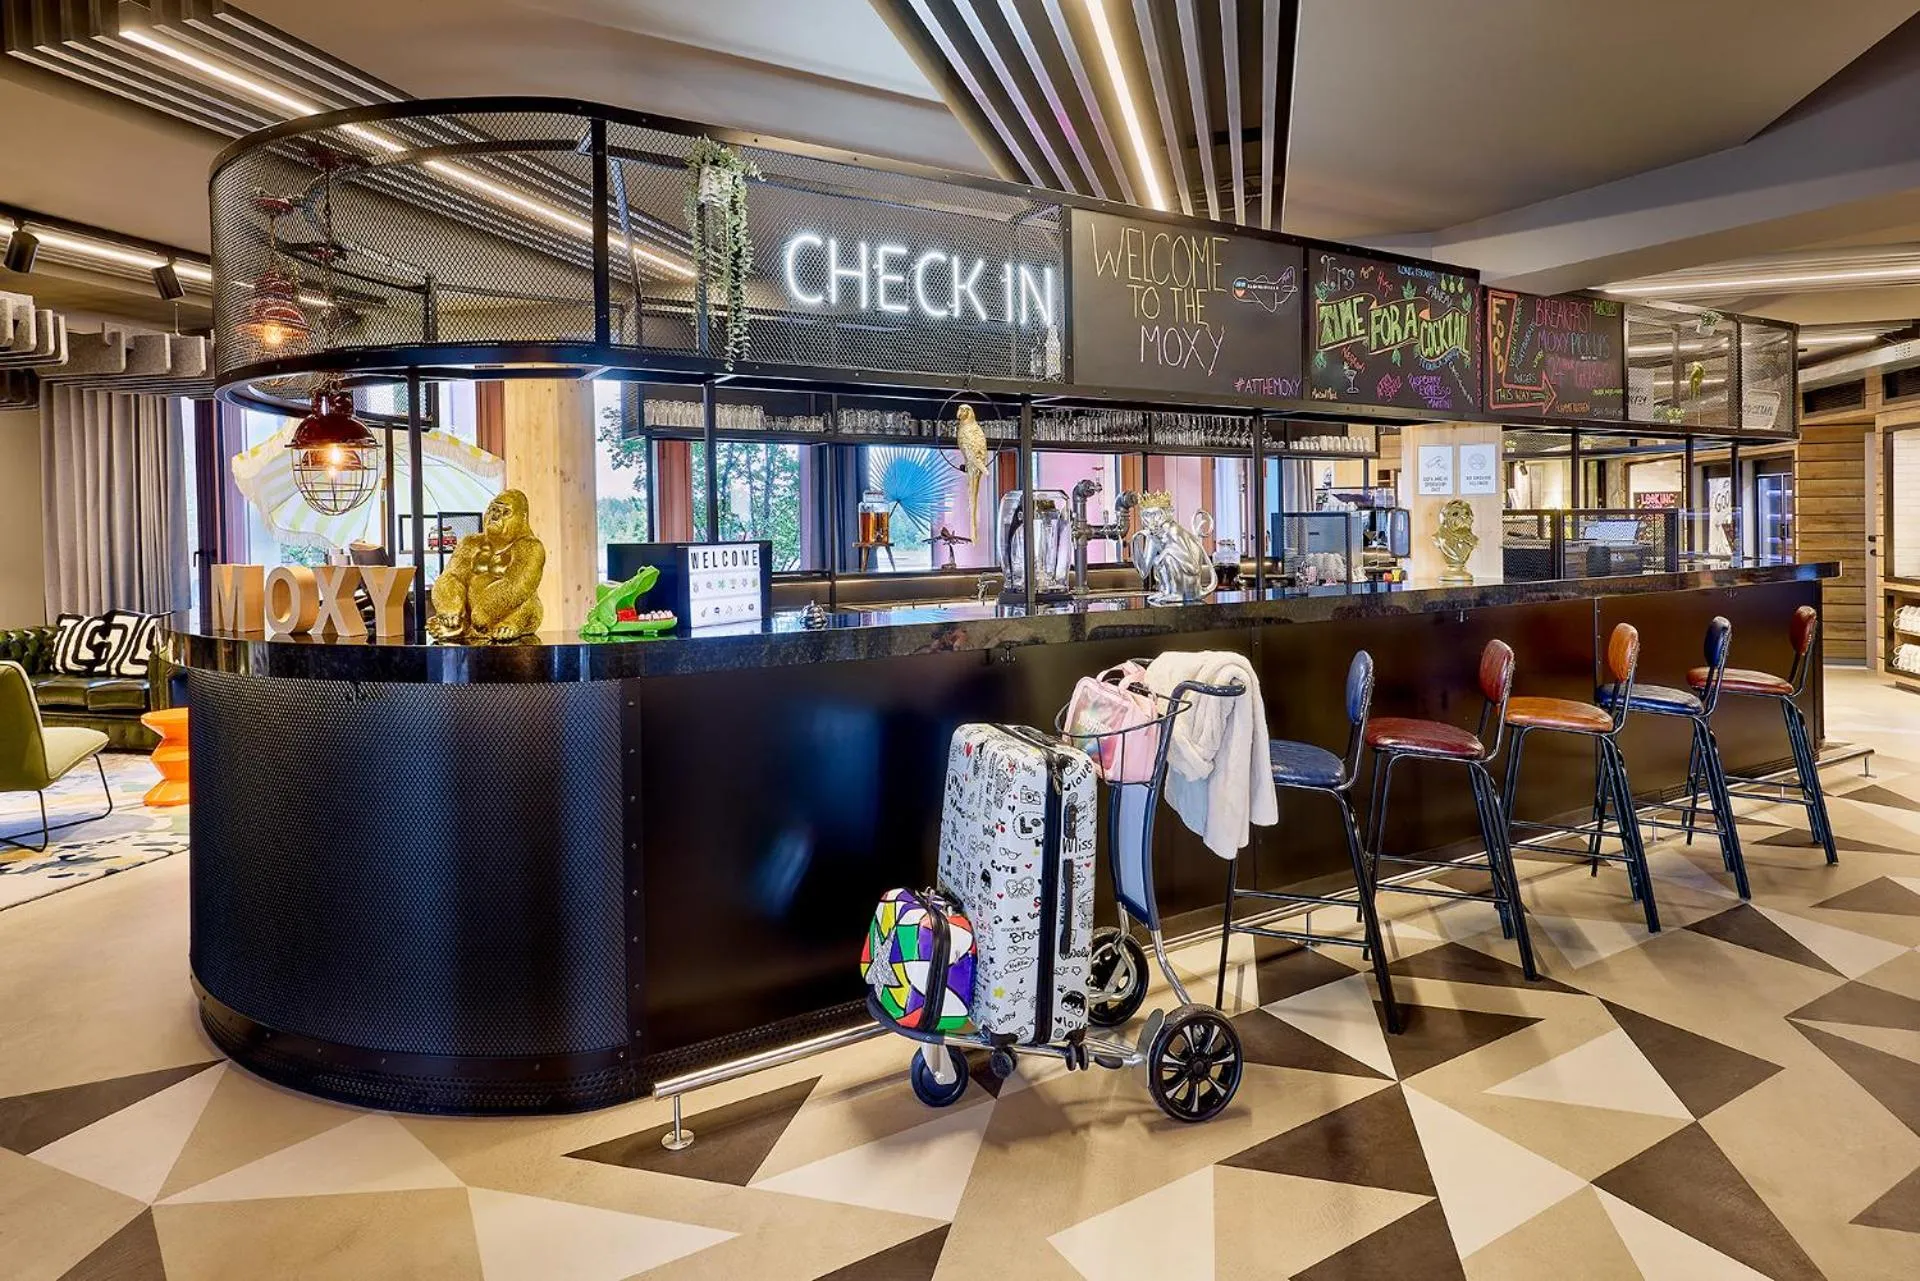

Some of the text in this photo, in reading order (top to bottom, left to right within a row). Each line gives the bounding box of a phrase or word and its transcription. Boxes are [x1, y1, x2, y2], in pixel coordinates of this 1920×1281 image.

[785, 233, 1053, 325] CHECK IN
[1091, 222, 1230, 293] WELCOME
[1126, 284, 1208, 326] TO THE
[1371, 302, 1418, 351] FOR A
[1140, 325, 1225, 377] MOXY
[691, 550, 759, 570] WELCOME
[211, 564, 417, 637] MOXY
